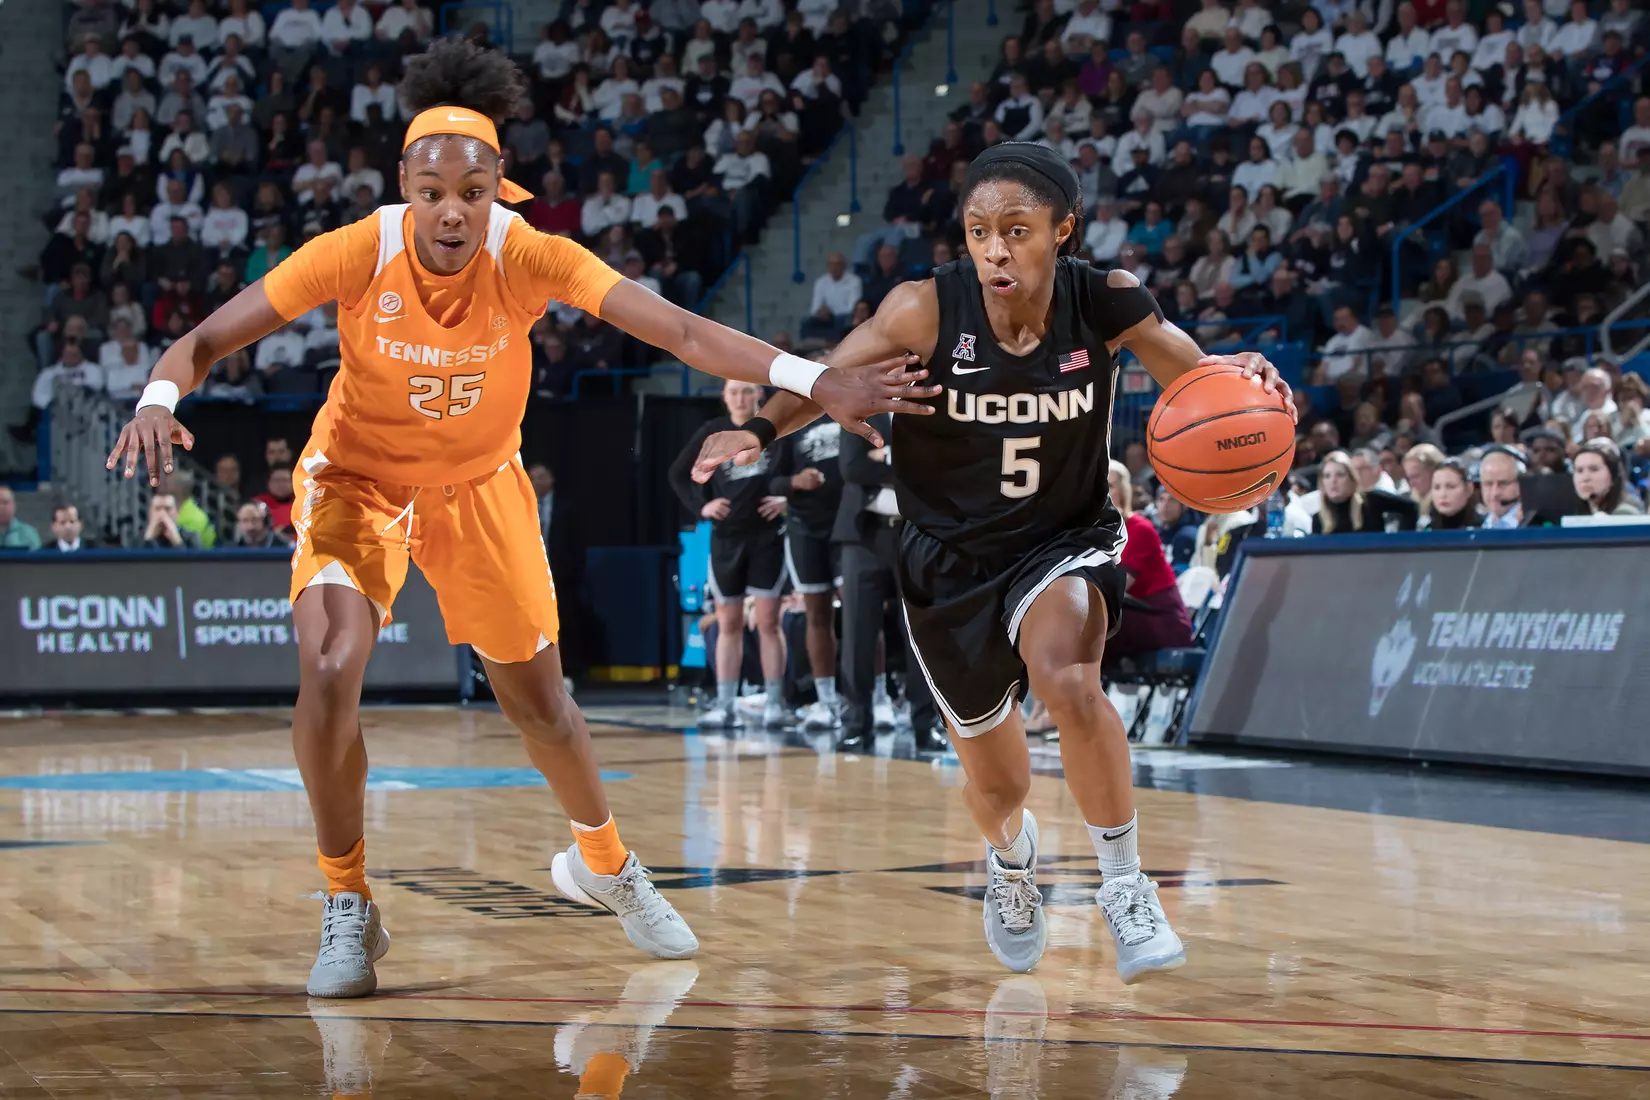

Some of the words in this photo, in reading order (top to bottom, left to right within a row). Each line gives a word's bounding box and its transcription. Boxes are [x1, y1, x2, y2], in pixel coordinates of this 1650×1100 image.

[376, 333, 510, 368] TENNESSEE
[408, 371, 486, 420] 25
[947, 382, 1094, 424] UCONN
[1217, 431, 1266, 451] UCONN
[1000, 436, 1041, 499] 5
[20, 596, 166, 629] UCONN
[193, 598, 294, 619] ORTHOP
[37, 632, 152, 653] HEALTH
[195, 625, 289, 645] SPORTS
[1427, 611, 1489, 648] TEAM
[1485, 611, 1624, 651] PHYSICIANS
